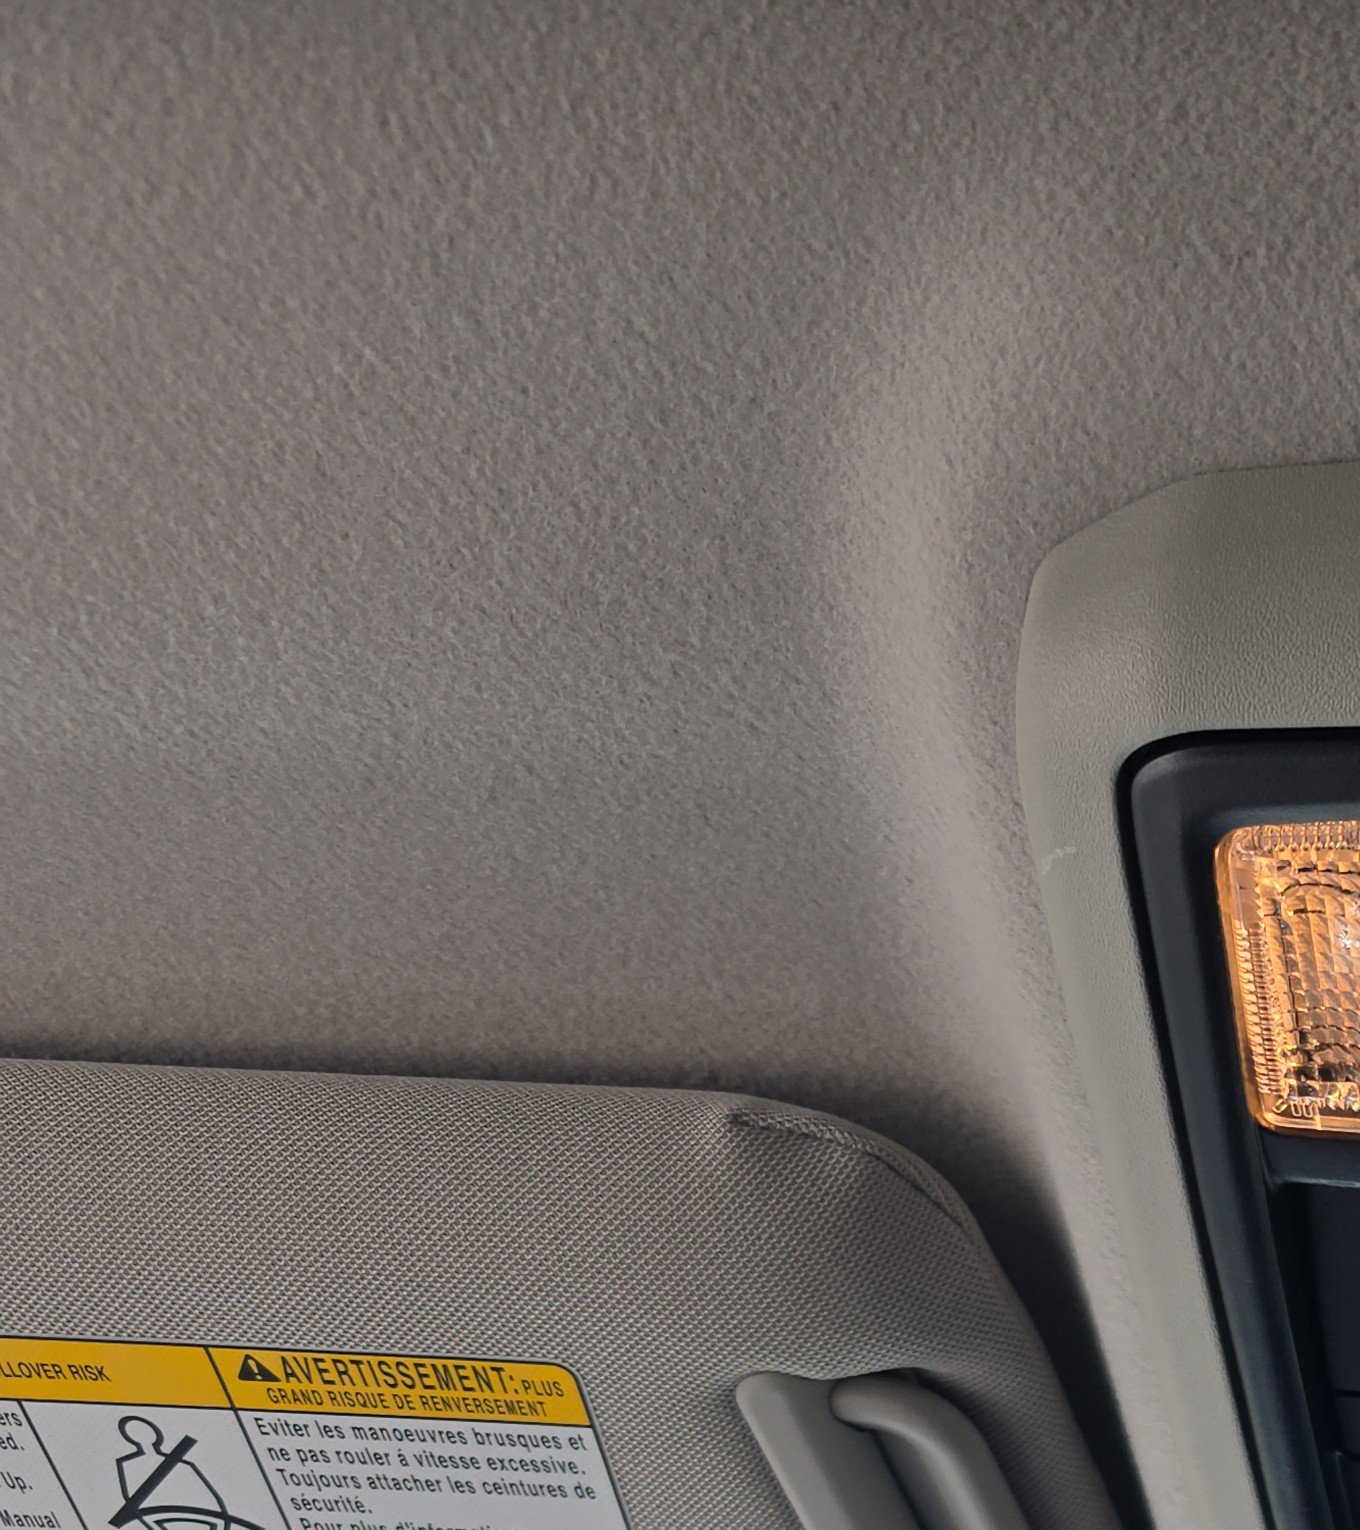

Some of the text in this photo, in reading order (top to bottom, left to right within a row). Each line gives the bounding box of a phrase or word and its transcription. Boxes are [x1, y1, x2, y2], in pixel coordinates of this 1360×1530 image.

[70, 1364, 112, 1382] RISK
[521, 1380, 564, 1397] PLUS
[267, 1388, 547, 1416] GRAND RISQUE DE RENVERSEMENT
[254, 1417, 587, 1452] Eviter les manoeuvres brusques et
[267, 1448, 291, 1461] ne
[296, 1449, 330, 1465] pas
[335, 1448, 391, 1466] rouler
[413, 1450, 481, 1470] vitesse
[487, 1456, 585, 1474] excessive.
[0, 1472, 33, 1494] Up.
[276, 1468, 595, 1499] Toujours attacher les ceintures de
[0, 1510, 61, 1528] Manual
